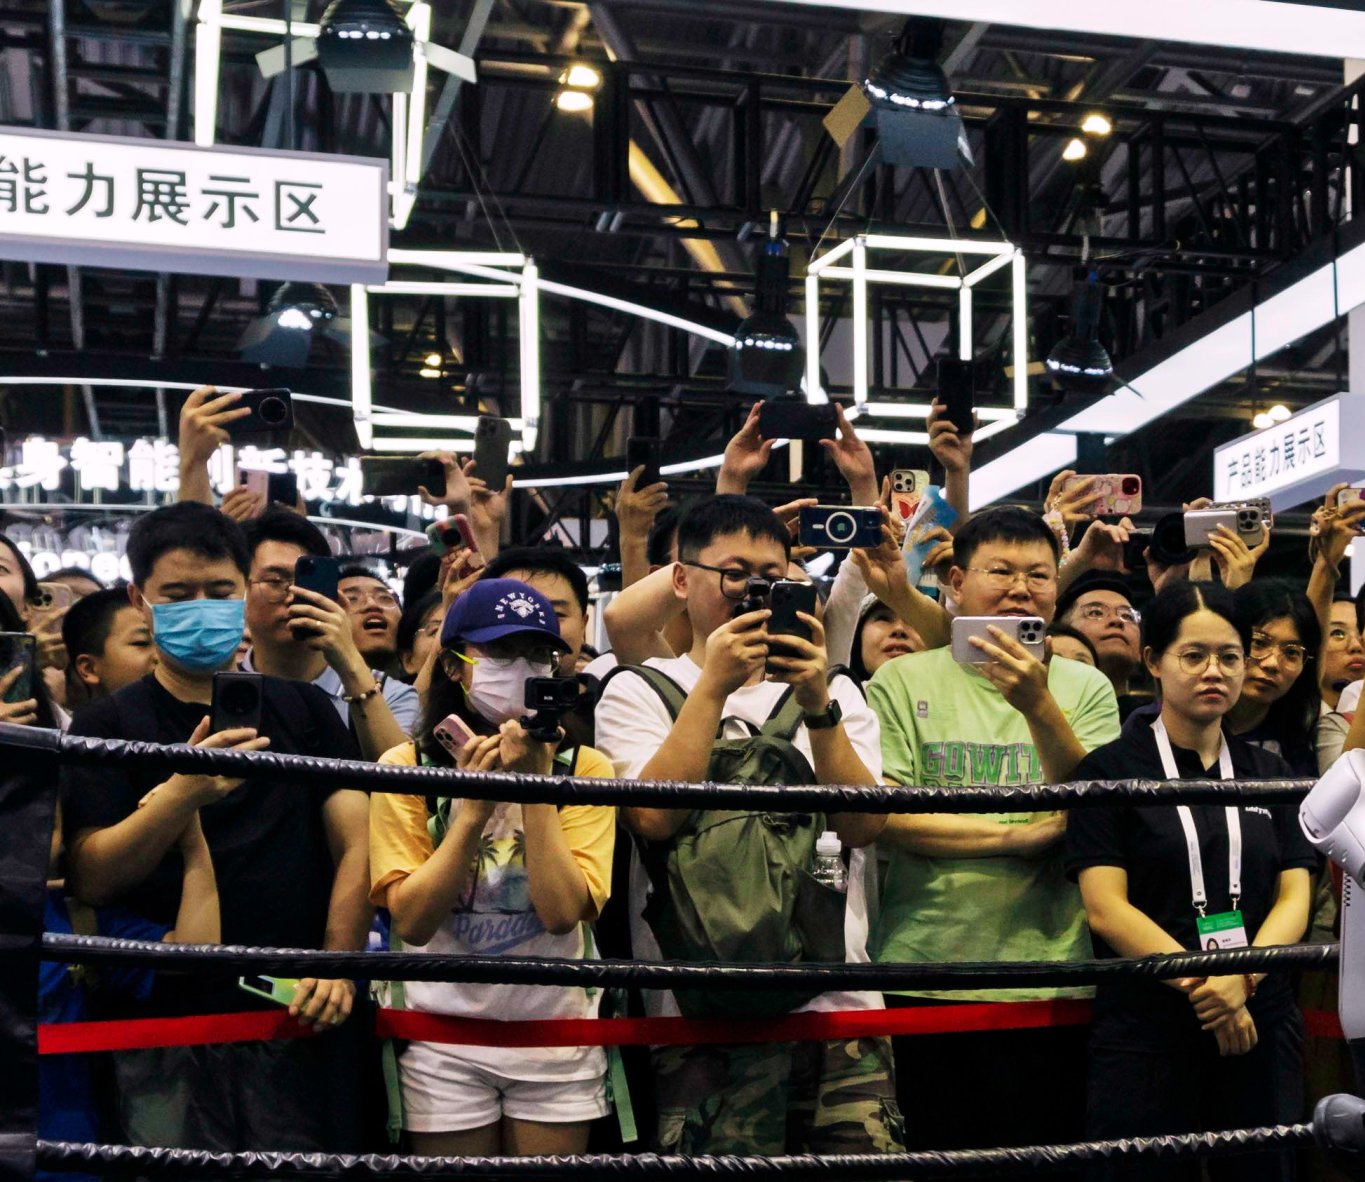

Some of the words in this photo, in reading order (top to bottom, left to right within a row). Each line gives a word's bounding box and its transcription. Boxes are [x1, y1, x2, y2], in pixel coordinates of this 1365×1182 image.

[0, 155, 326, 234] 能力展示区
[1226, 420, 1326, 495] 产品能力展示区
